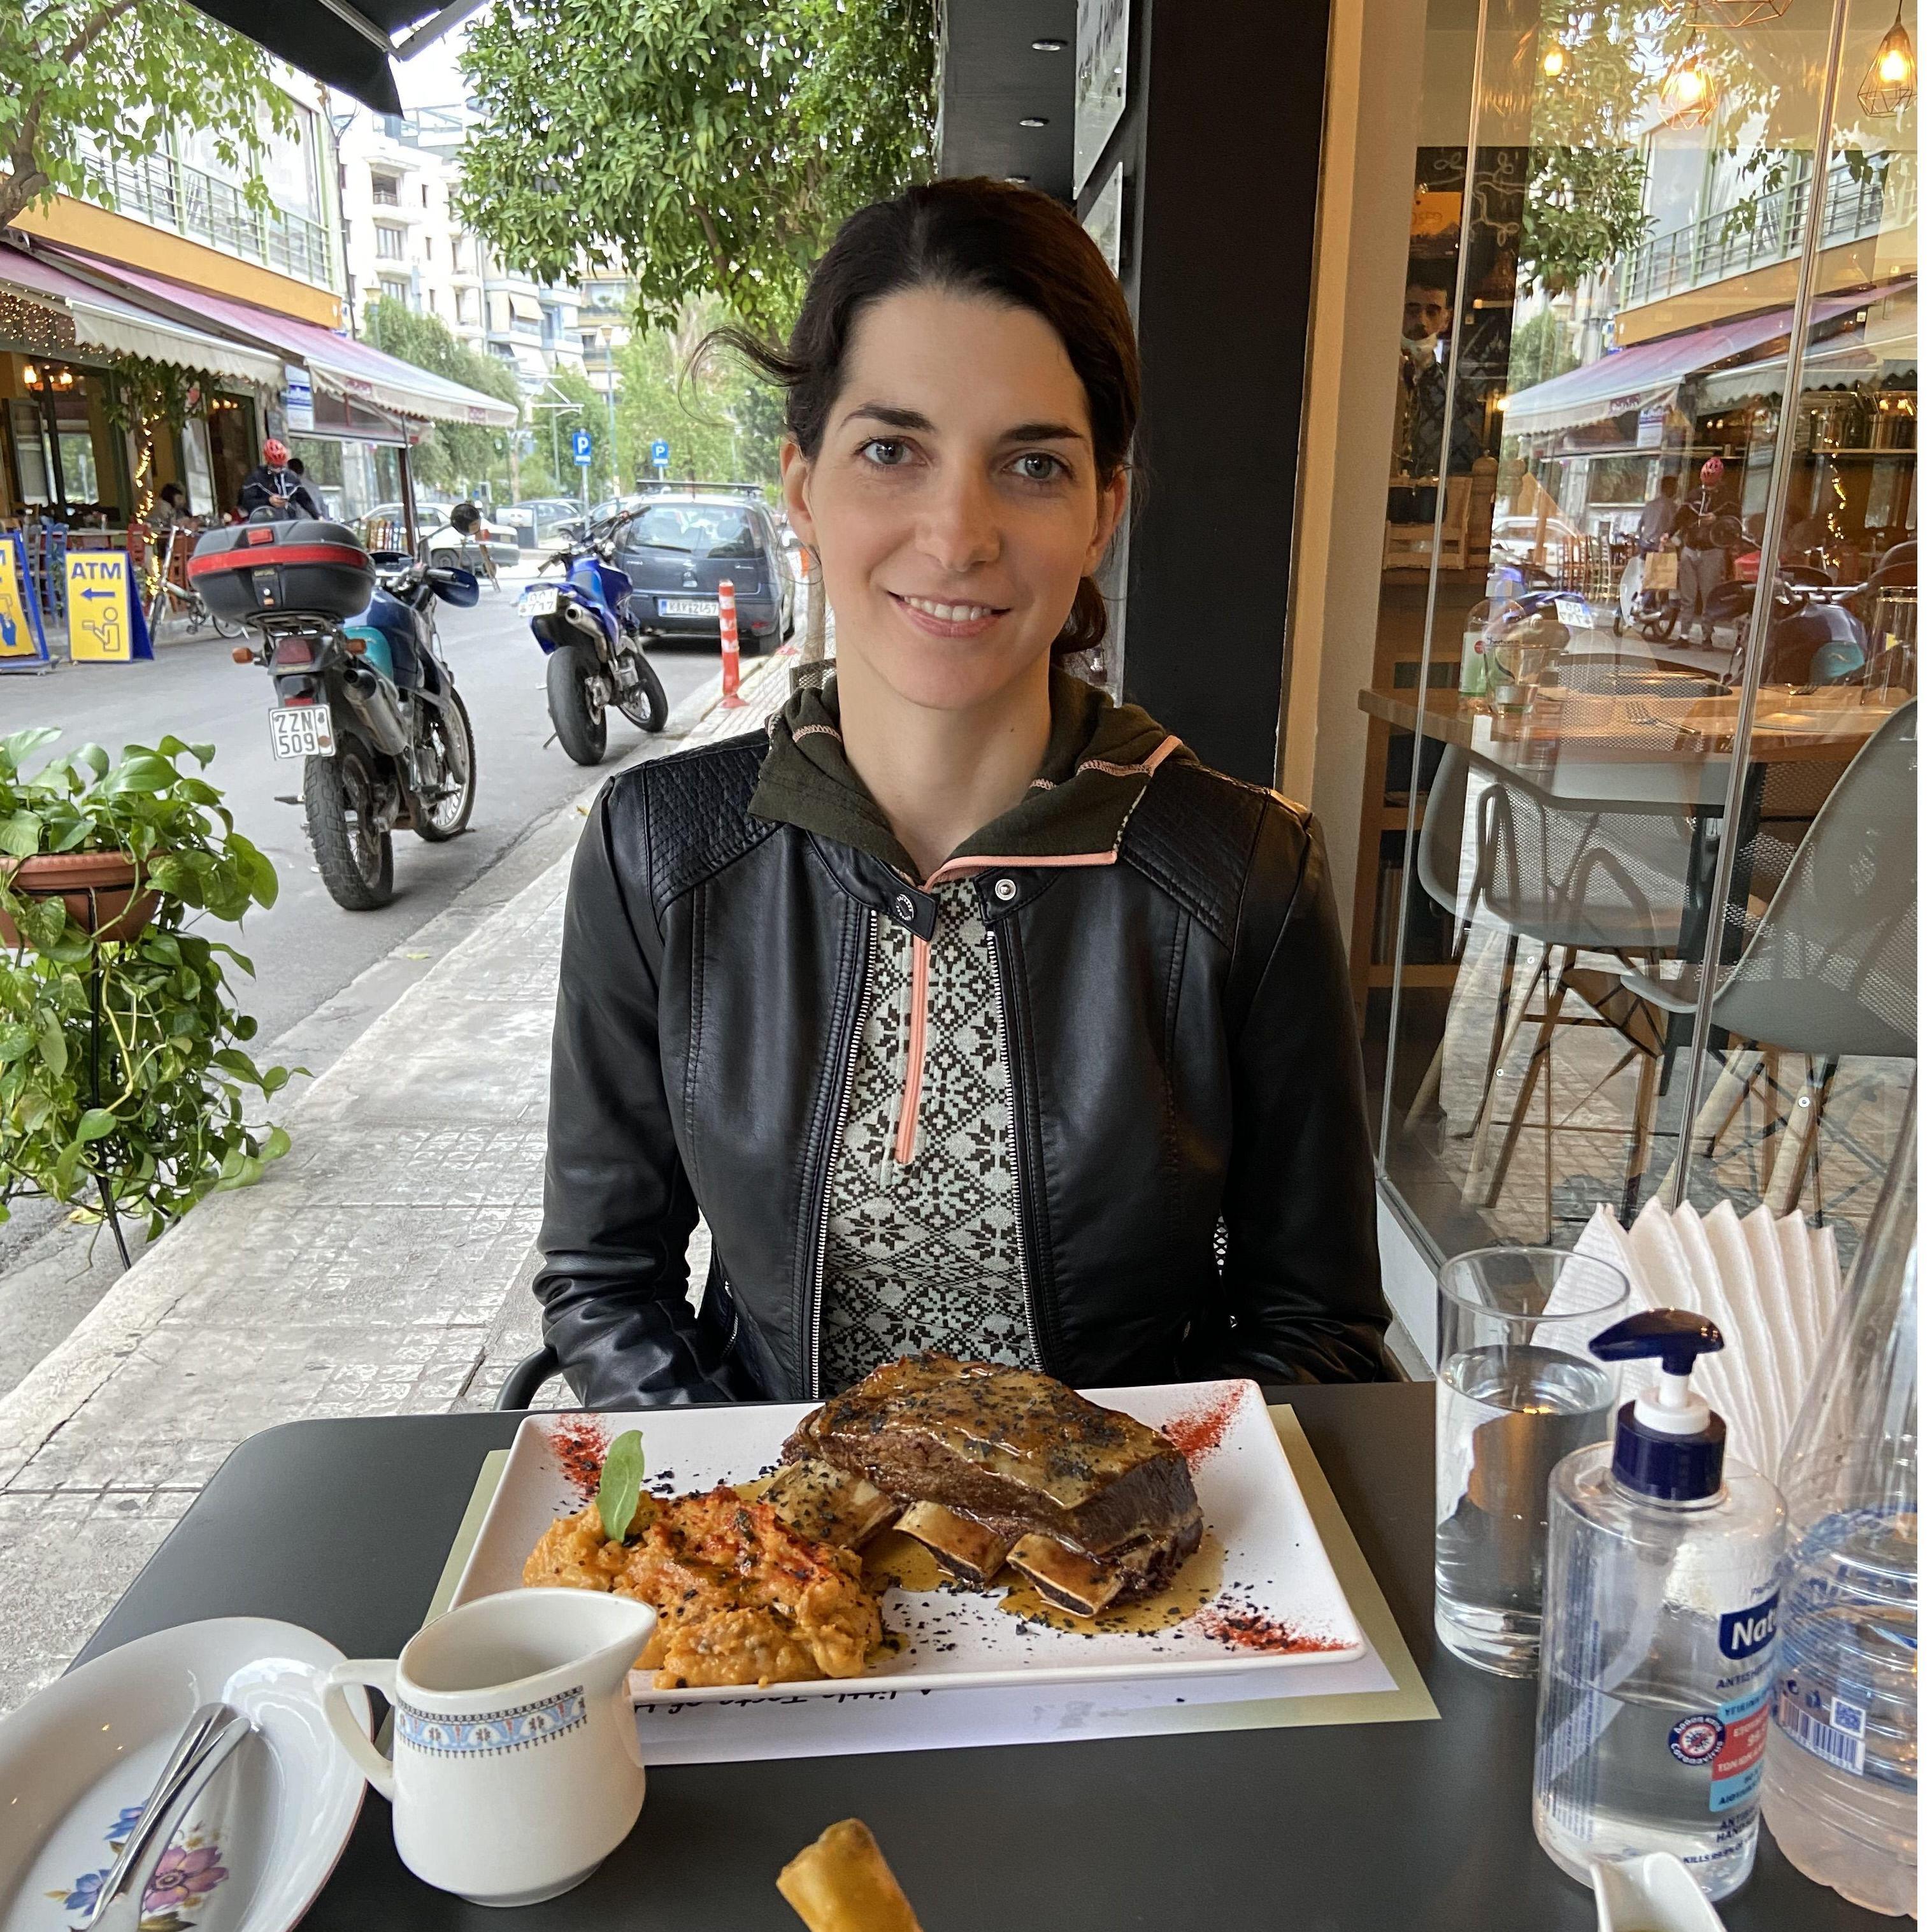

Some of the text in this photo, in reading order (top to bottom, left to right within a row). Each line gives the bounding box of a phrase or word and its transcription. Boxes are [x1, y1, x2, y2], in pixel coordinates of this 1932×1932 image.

[577, 436, 589, 454] P
[655, 446, 665, 457] P
[71, 562, 122, 580] ATM
[275, 712, 313, 733] ZZN
[279, 733, 315, 755] 509
[1683, 1854, 1710, 1864] KILLS
